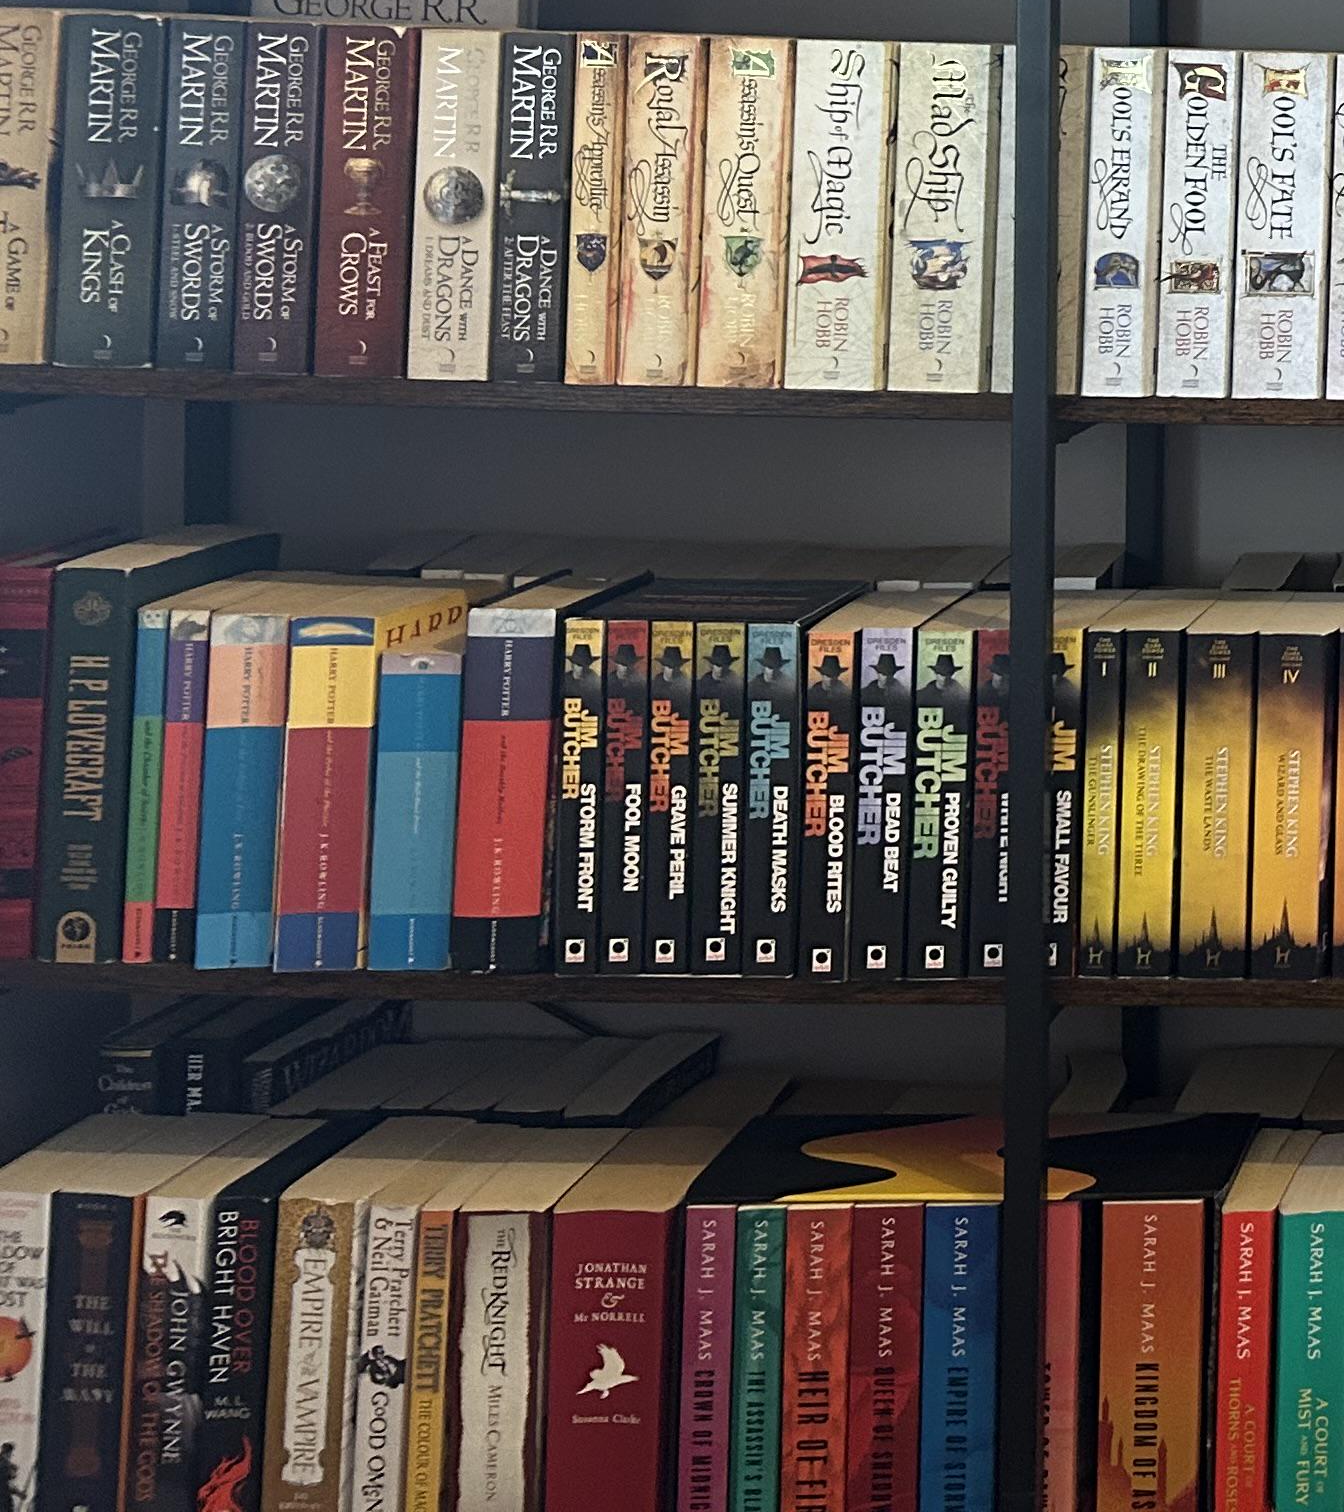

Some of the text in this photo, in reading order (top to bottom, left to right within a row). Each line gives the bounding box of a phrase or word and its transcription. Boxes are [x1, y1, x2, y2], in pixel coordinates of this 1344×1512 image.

[88, 28, 123, 144] MARTIN
[1098, 307, 1112, 354] HOBB
[1114, 305, 1131, 357] ROBIN
[327, 647, 338, 725] HARRY POTTER
[63, 699, 107, 822] LOVECRAFT
[770, 786, 788, 913] DEATH MASKS
[210, 1210, 238, 1383] BRIGHT HAVEN
[575, 1263, 647, 1275] JONATHAN
[575, 1277, 645, 1290] STRANGE
